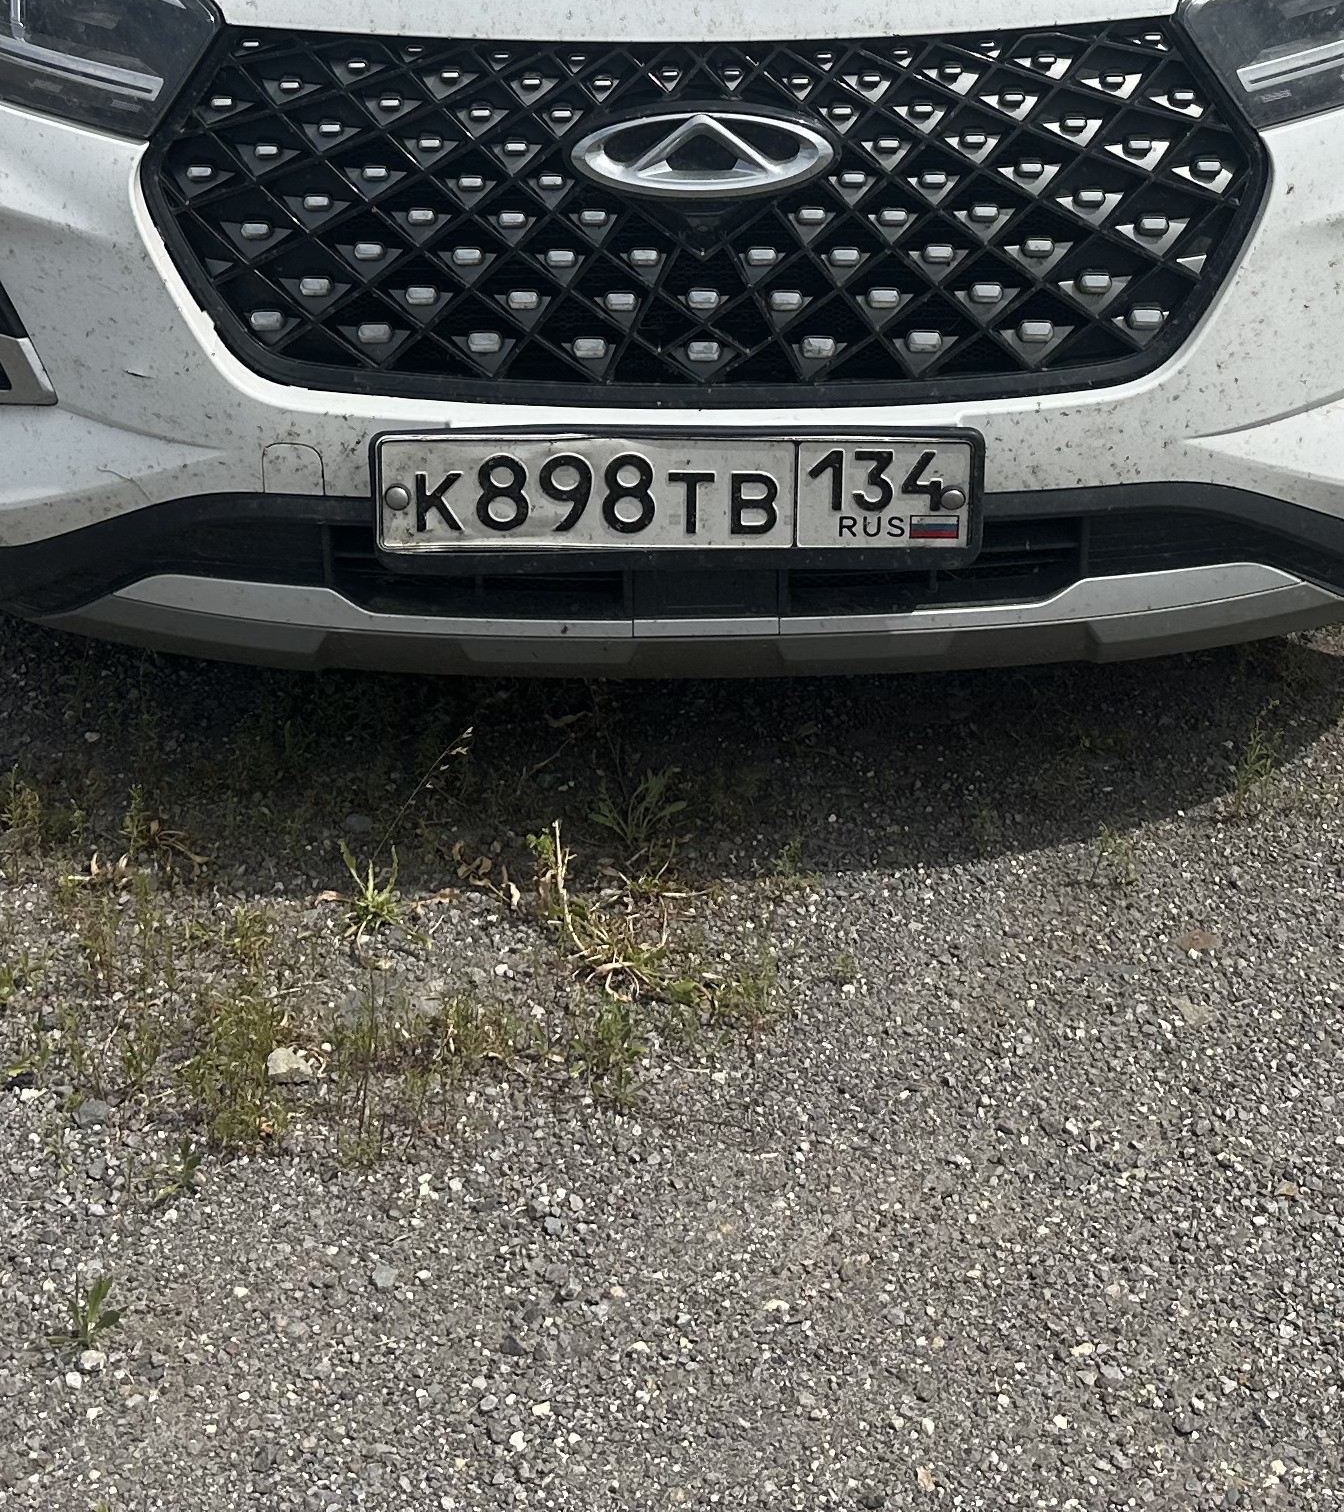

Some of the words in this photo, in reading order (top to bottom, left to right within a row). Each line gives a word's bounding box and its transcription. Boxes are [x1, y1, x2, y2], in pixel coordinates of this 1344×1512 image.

[414, 452, 779, 536] К898ТВ
[807, 448, 945, 513] 134
[838, 515, 906, 539] RUS
